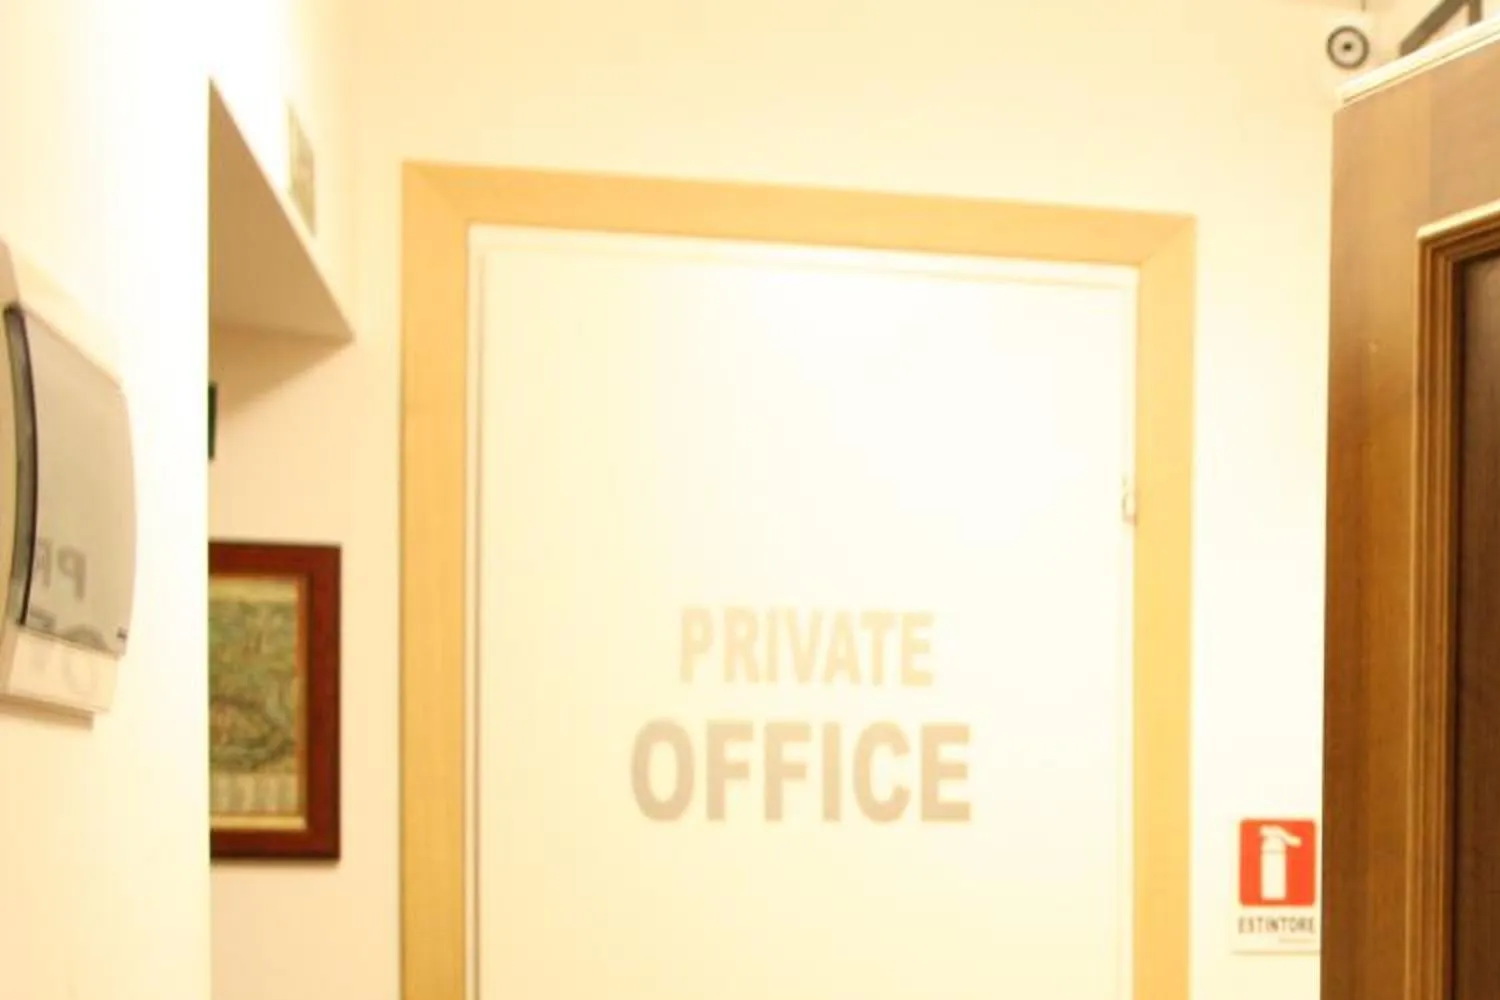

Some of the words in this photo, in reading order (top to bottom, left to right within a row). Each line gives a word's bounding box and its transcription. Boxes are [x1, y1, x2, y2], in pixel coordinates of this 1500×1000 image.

[679, 605, 936, 688] PRIVATE
[630, 717, 973, 824] OFFICE
[1237, 915, 1317, 935] ESTINTORE
